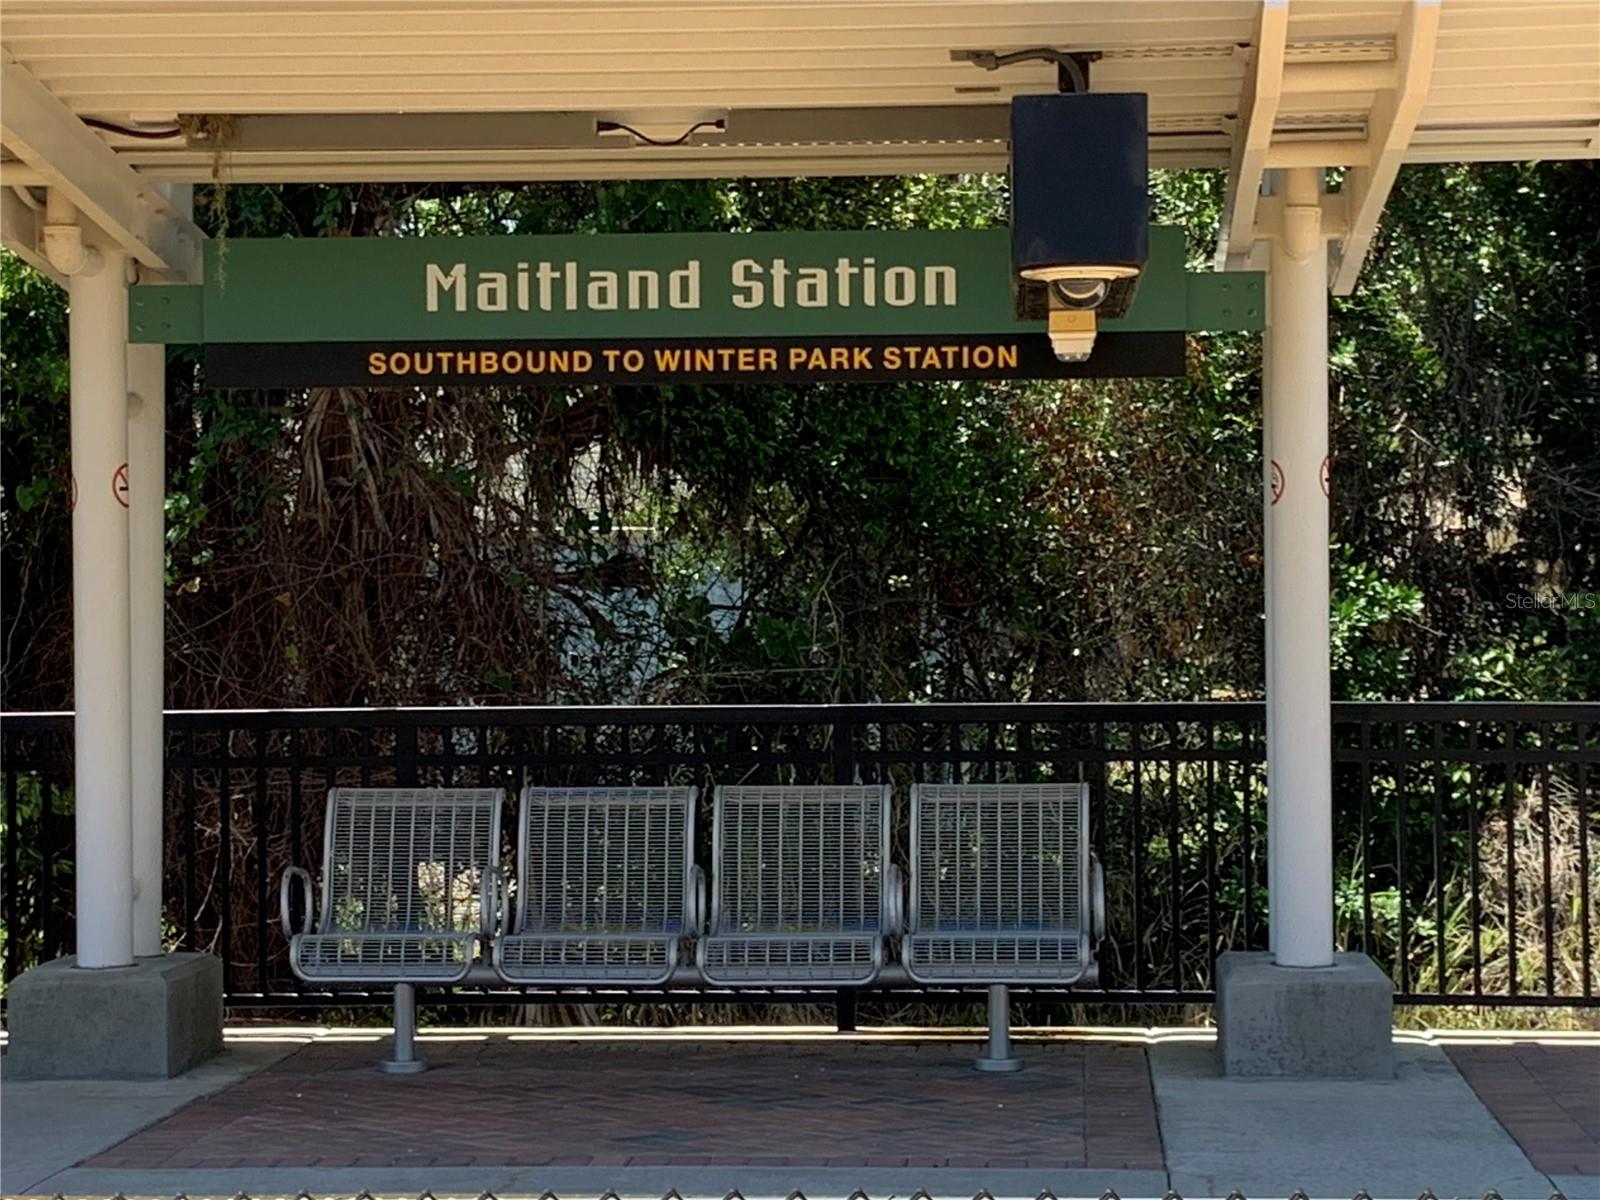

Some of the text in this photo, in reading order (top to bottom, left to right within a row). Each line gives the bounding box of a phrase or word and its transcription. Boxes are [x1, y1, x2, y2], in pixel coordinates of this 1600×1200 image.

[426, 258, 956, 311] Maitland Station
[369, 346, 1018, 375] SOUTHBOUND TO WINTER PARK STATION
